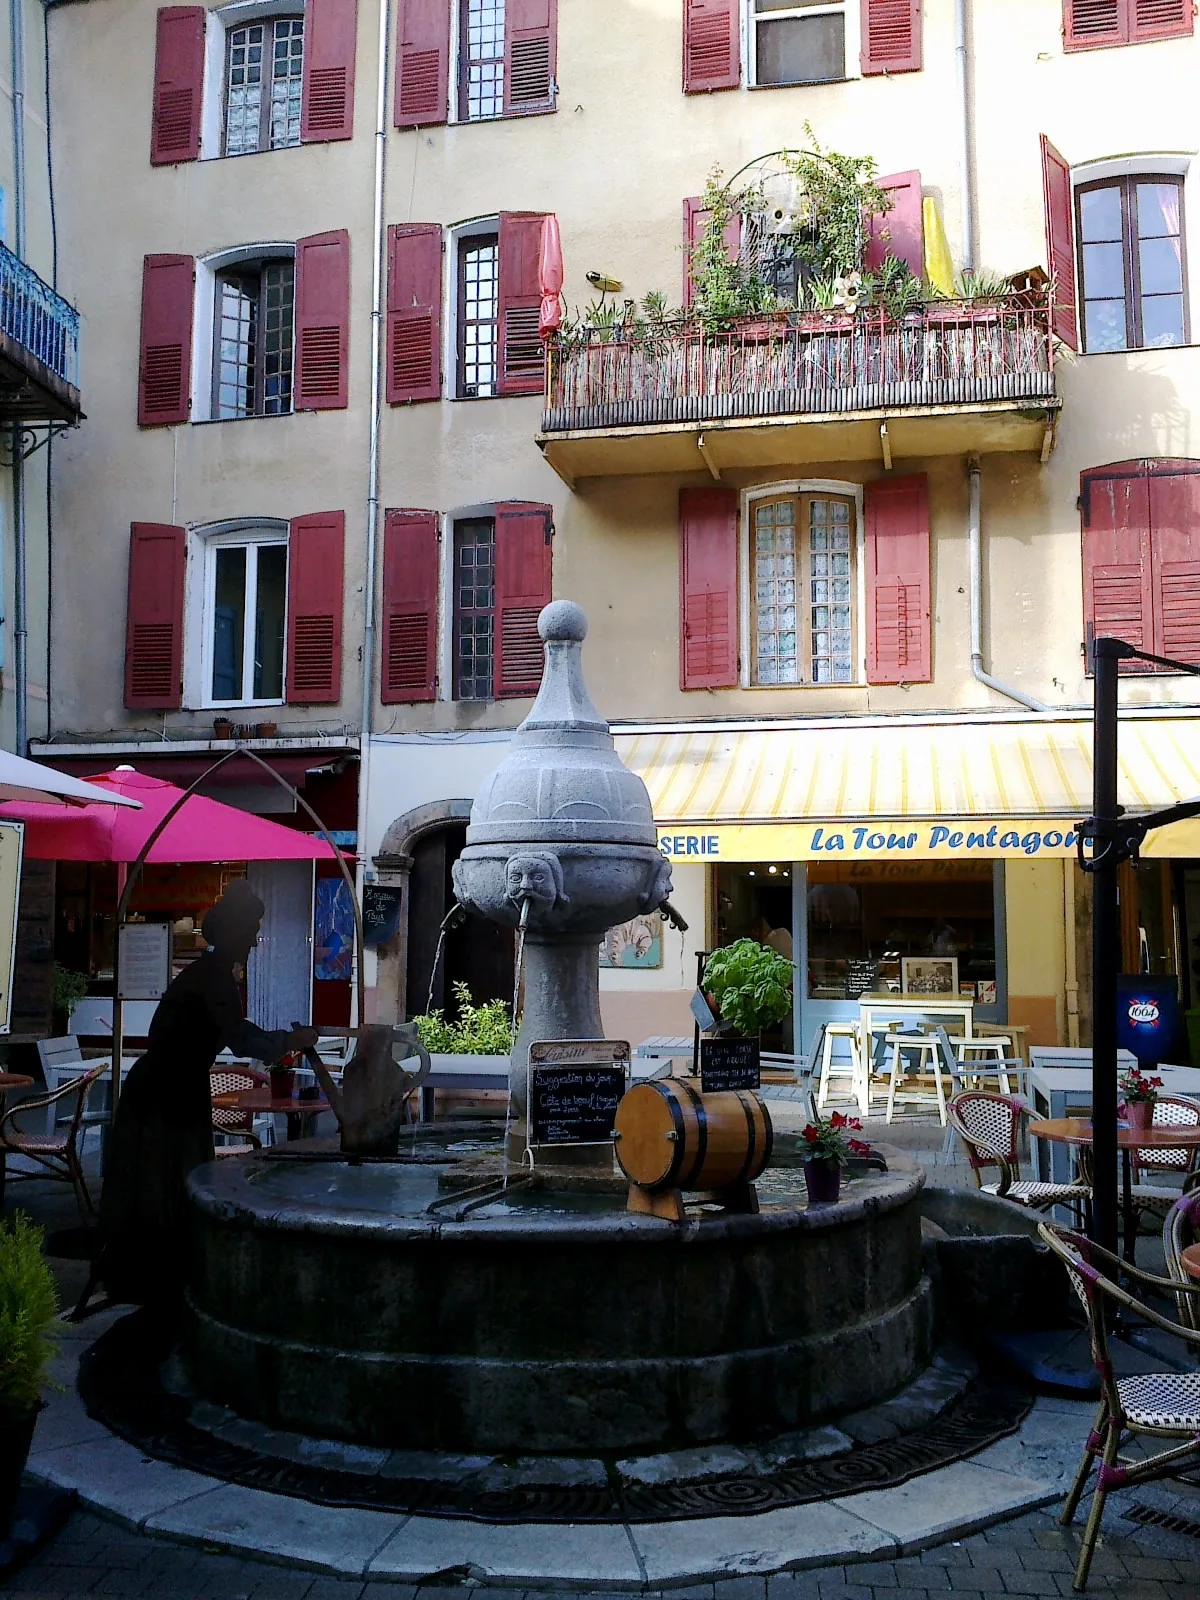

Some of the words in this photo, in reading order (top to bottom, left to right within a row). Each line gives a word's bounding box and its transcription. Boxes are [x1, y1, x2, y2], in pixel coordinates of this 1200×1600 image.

[660, 836, 719, 854] SERIE
[810, 828, 845, 851] La
[852, 827, 918, 850] Tour
[1131, 1005, 1156, 1018] 1664
